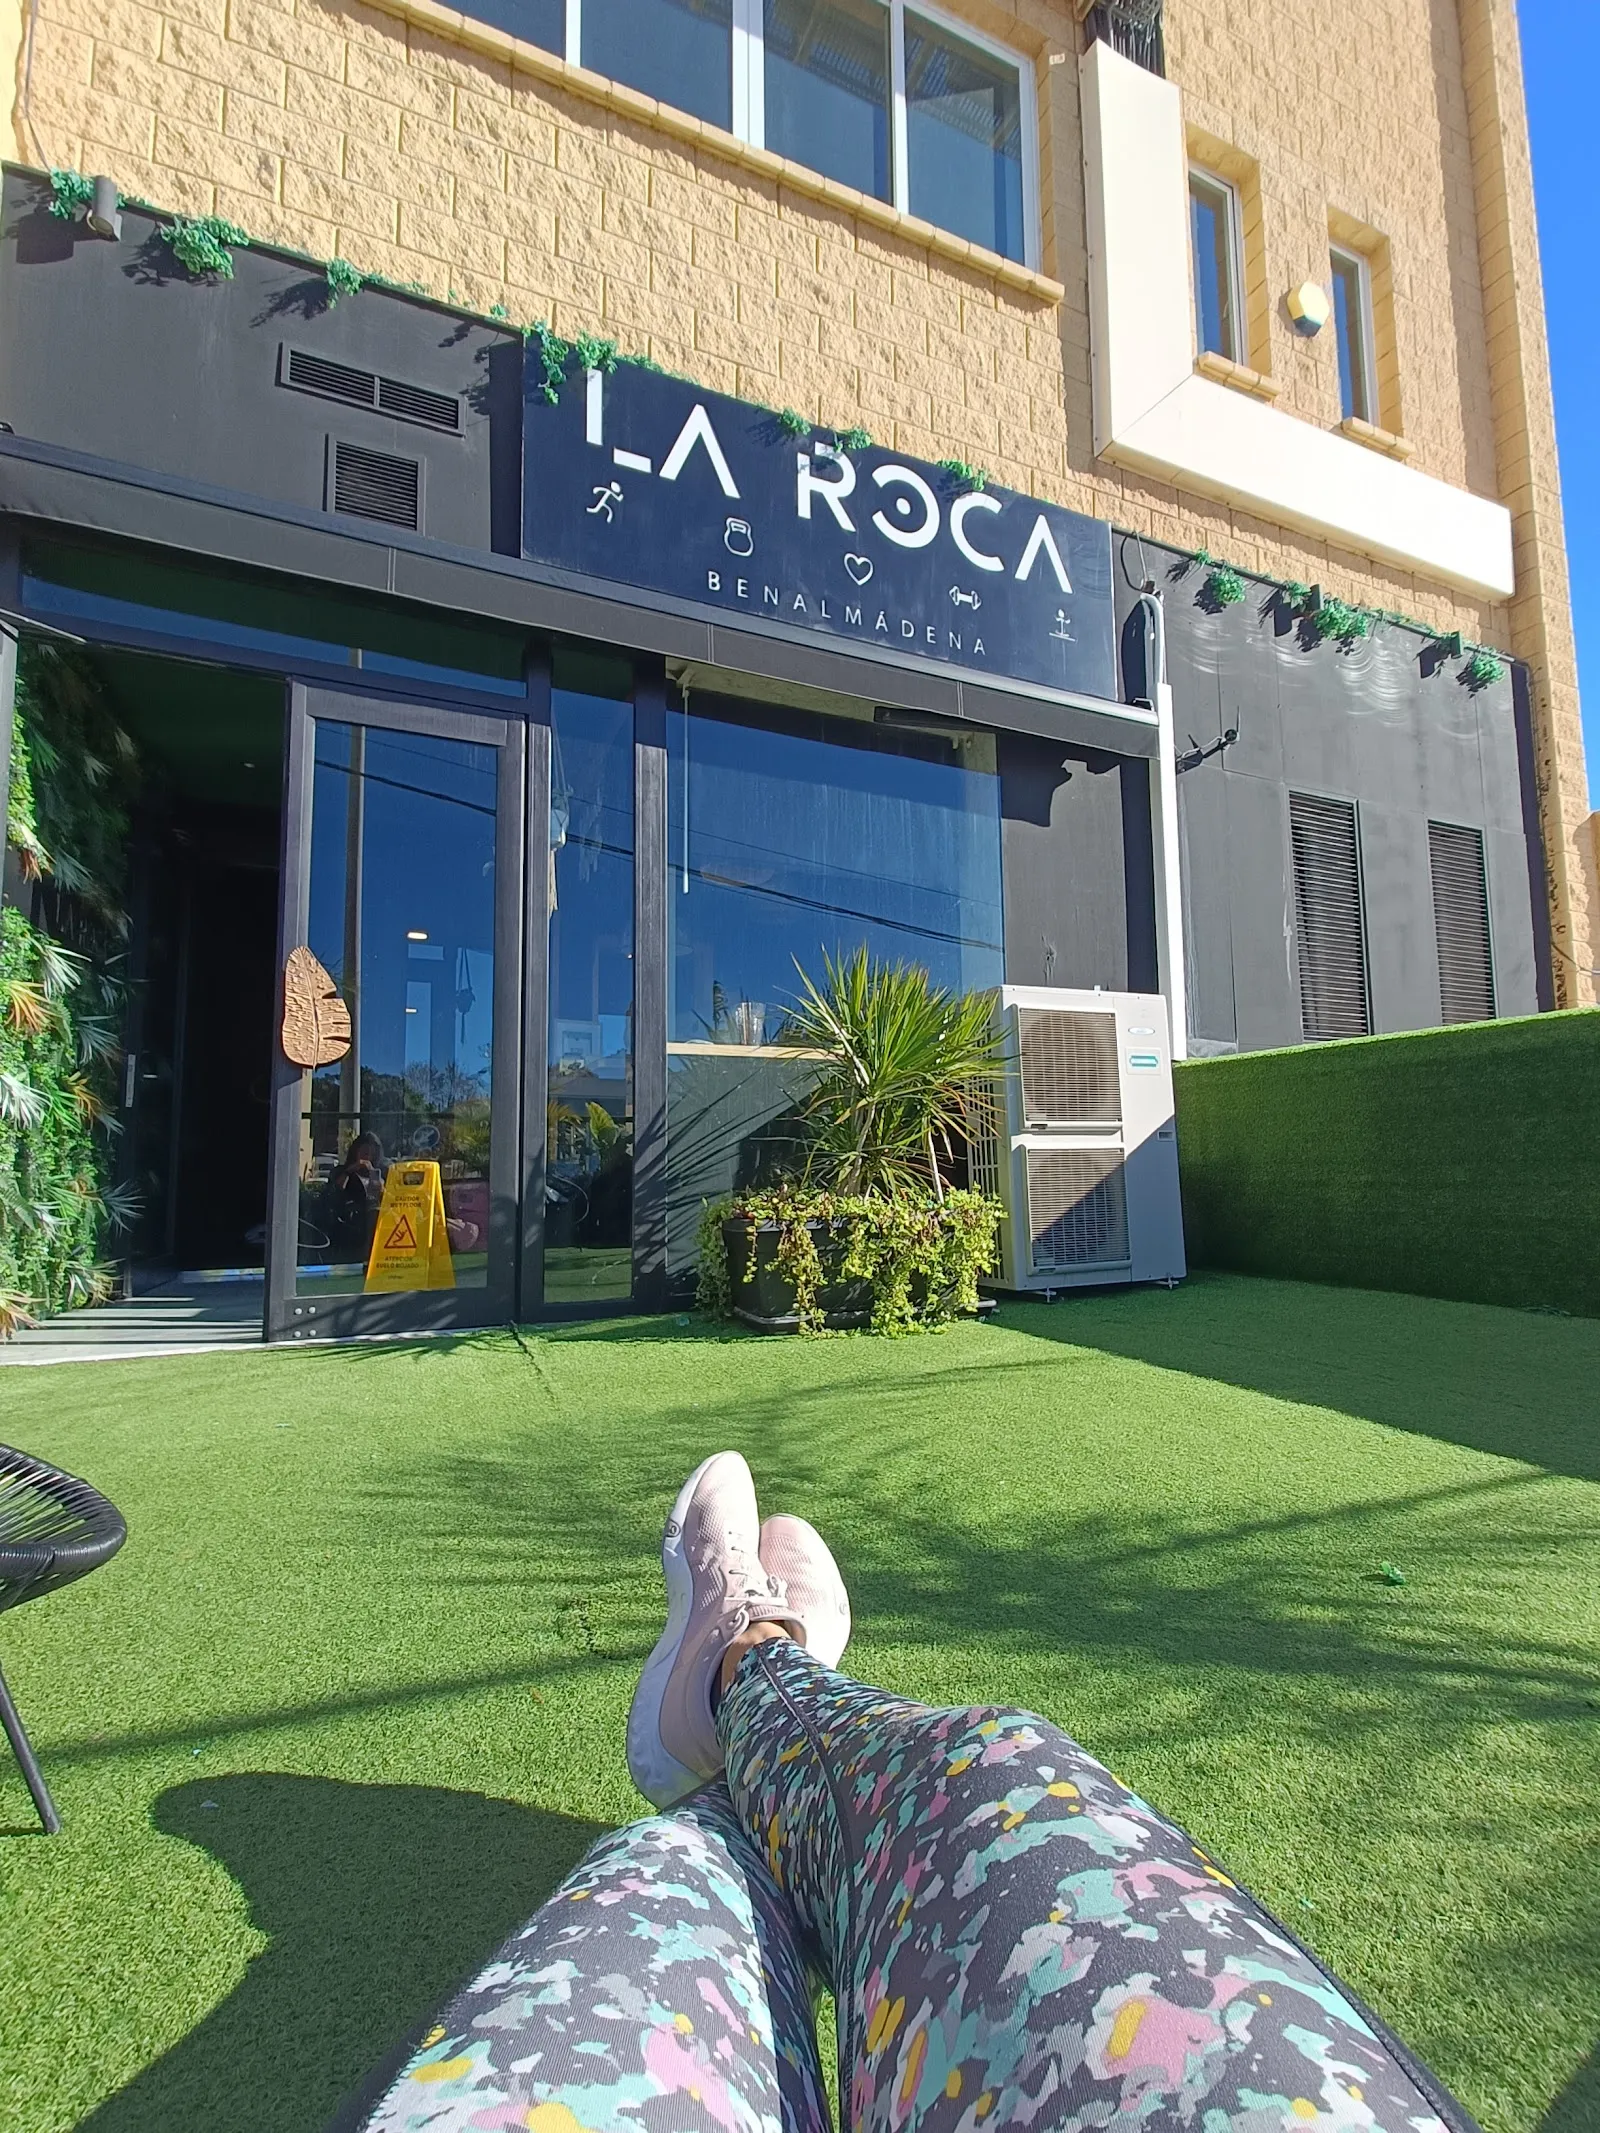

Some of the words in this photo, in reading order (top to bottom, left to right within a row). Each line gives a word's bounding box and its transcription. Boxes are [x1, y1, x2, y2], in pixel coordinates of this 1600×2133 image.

[585, 368, 741, 500] LA
[796, 441, 1074, 595] ROCA
[707, 570, 987, 656] BENALMÁDENA
